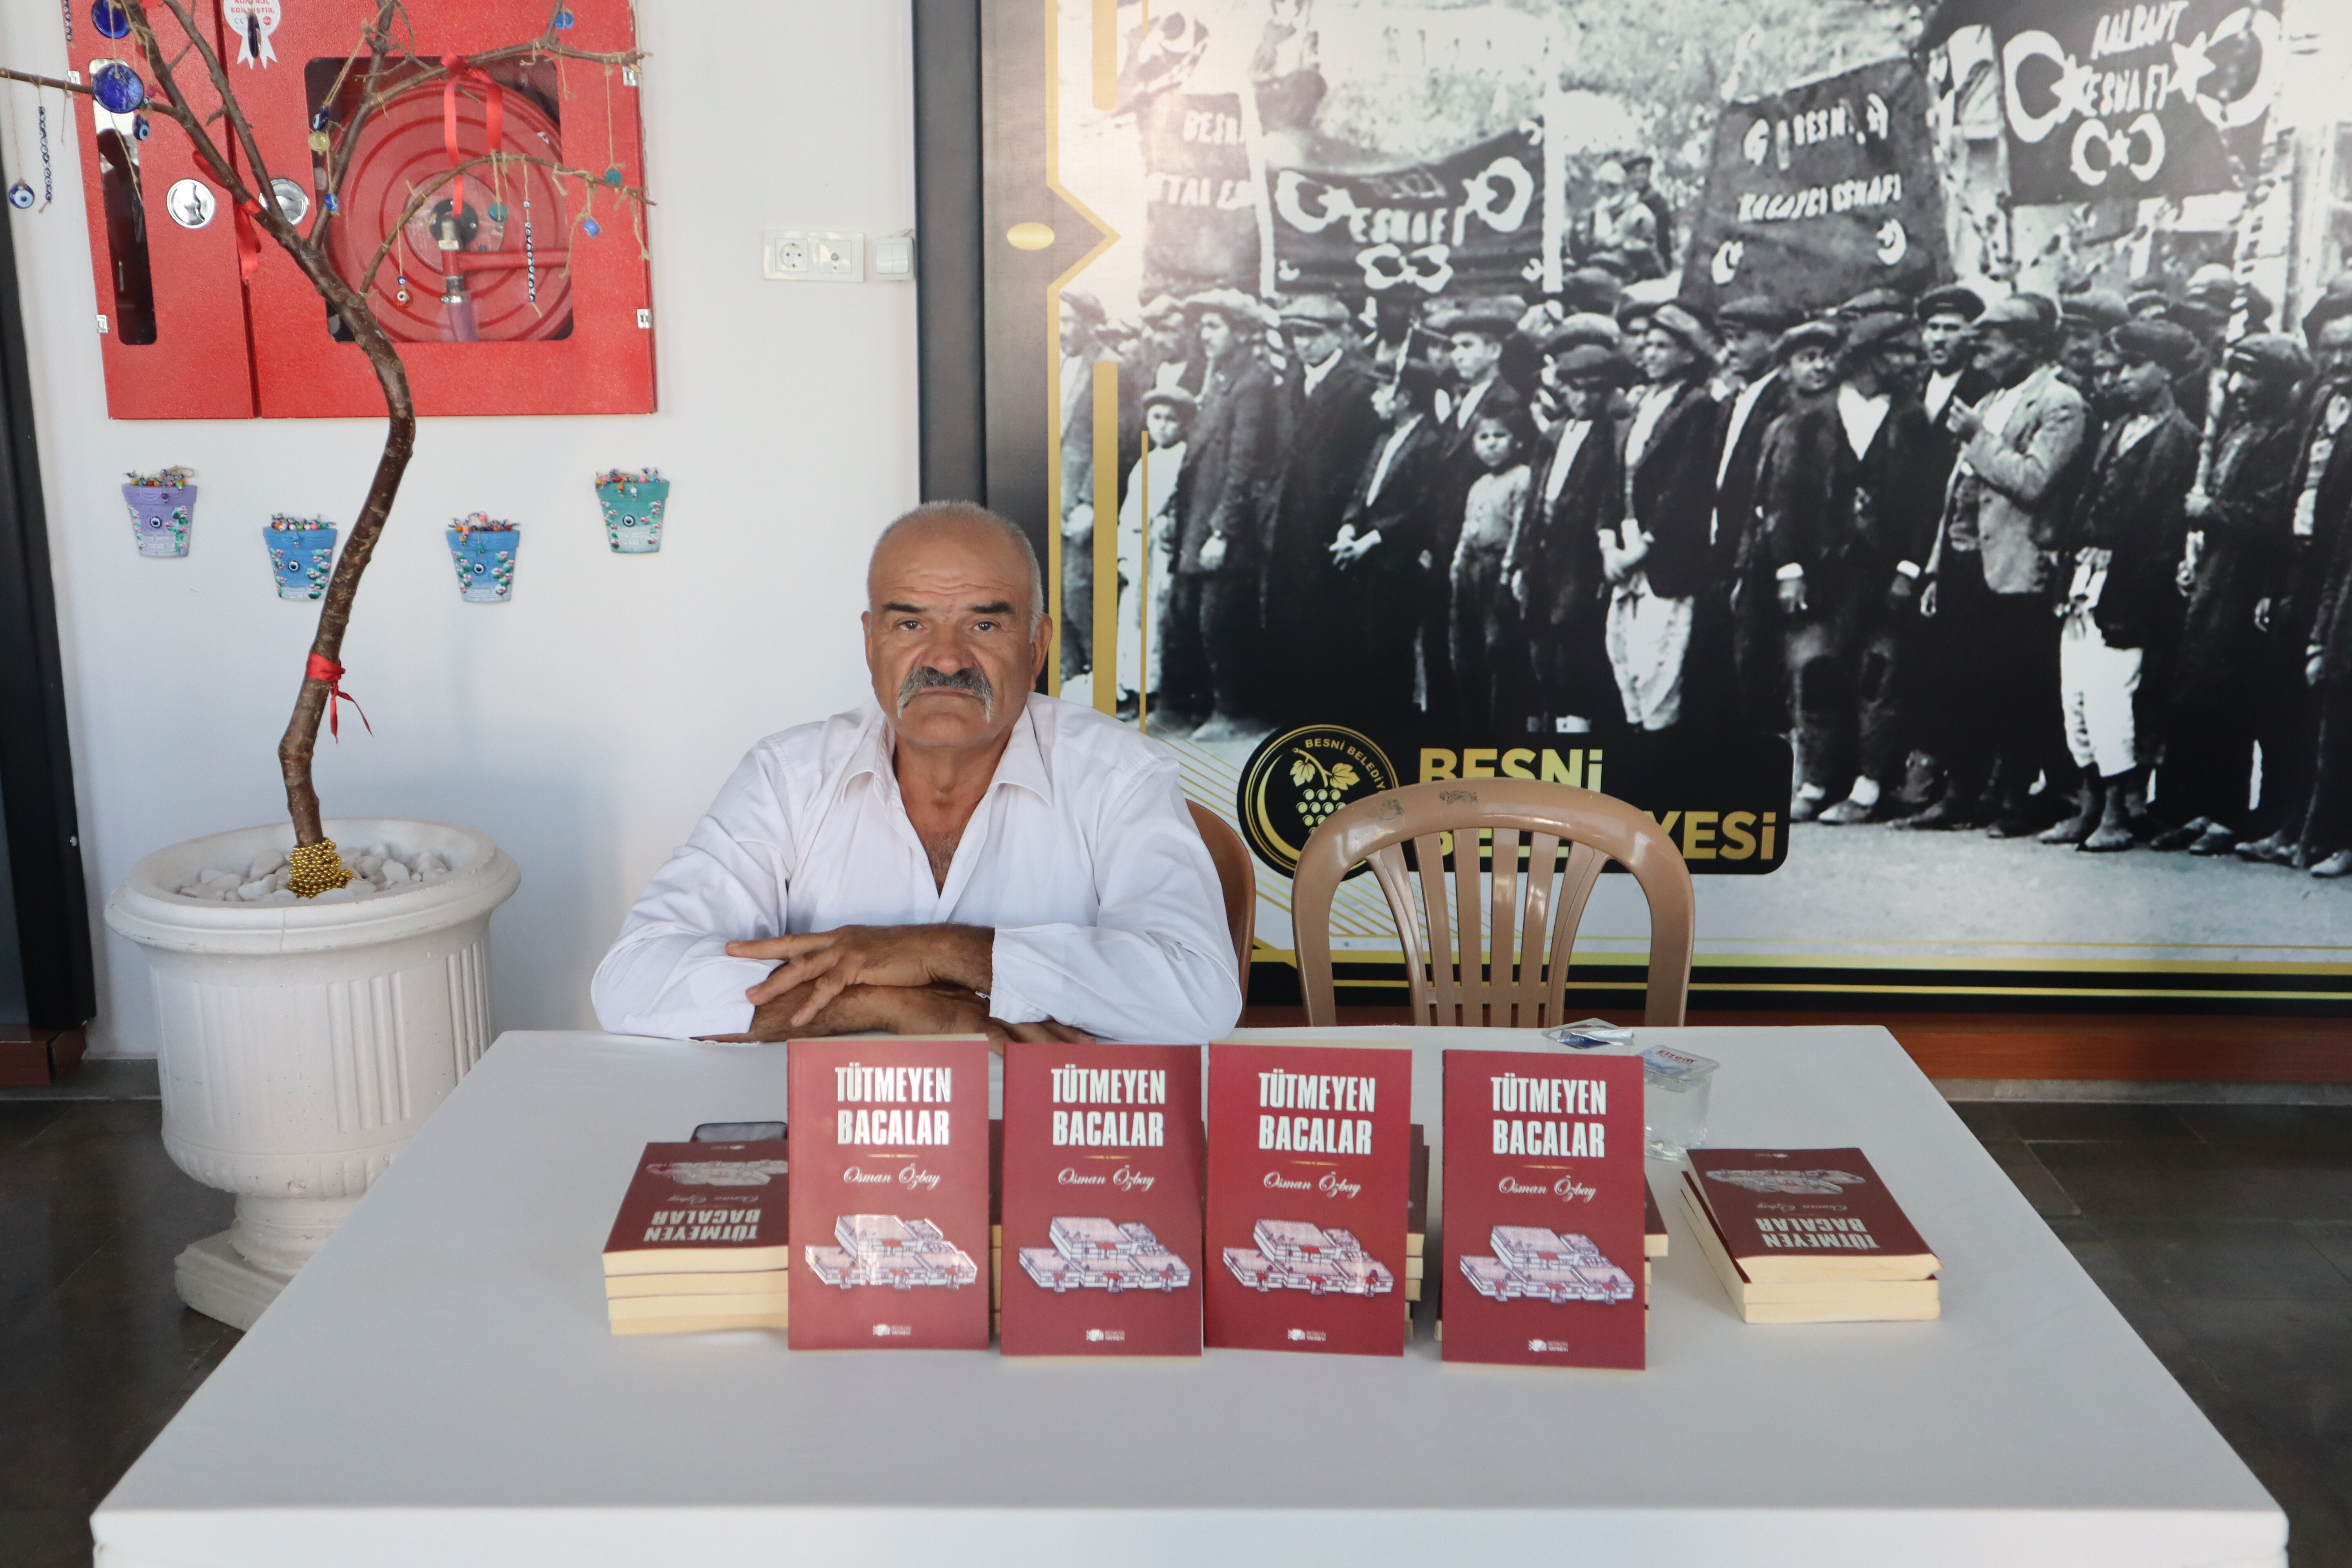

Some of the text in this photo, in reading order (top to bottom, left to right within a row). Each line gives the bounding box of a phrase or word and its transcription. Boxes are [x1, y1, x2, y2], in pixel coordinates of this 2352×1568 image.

[1347, 746, 1386, 789] BELEDİY
[835, 1062, 951, 1102] TÜTMEYEN
[1051, 1064, 1165, 1104] TÜTMEYEN
[1258, 1069, 1376, 1112] TÜTMEYEN
[1490, 1073, 1606, 1114] TÜTMEYEN
[837, 1110, 949, 1145] BACALAR
[1053, 1111, 1163, 1146] BACALAR
[1258, 1115, 1372, 1155] BACALAR
[1493, 1119, 1605, 1158] BACALAR
[844, 1163, 940, 1189] Osman Özbay
[1058, 1165, 1155, 1192] Osman Özbay
[1263, 1171, 1361, 1198] Osman Özbay
[1498, 1175, 1597, 1202] Osman Özbay
[643, 1225, 757, 1242] TÜTMEYEN
[651, 1209, 761, 1225] BACALAR
[1755, 1218, 1867, 1232] BACALAR
[1762, 1234, 1880, 1250] TÜTMEYEN
